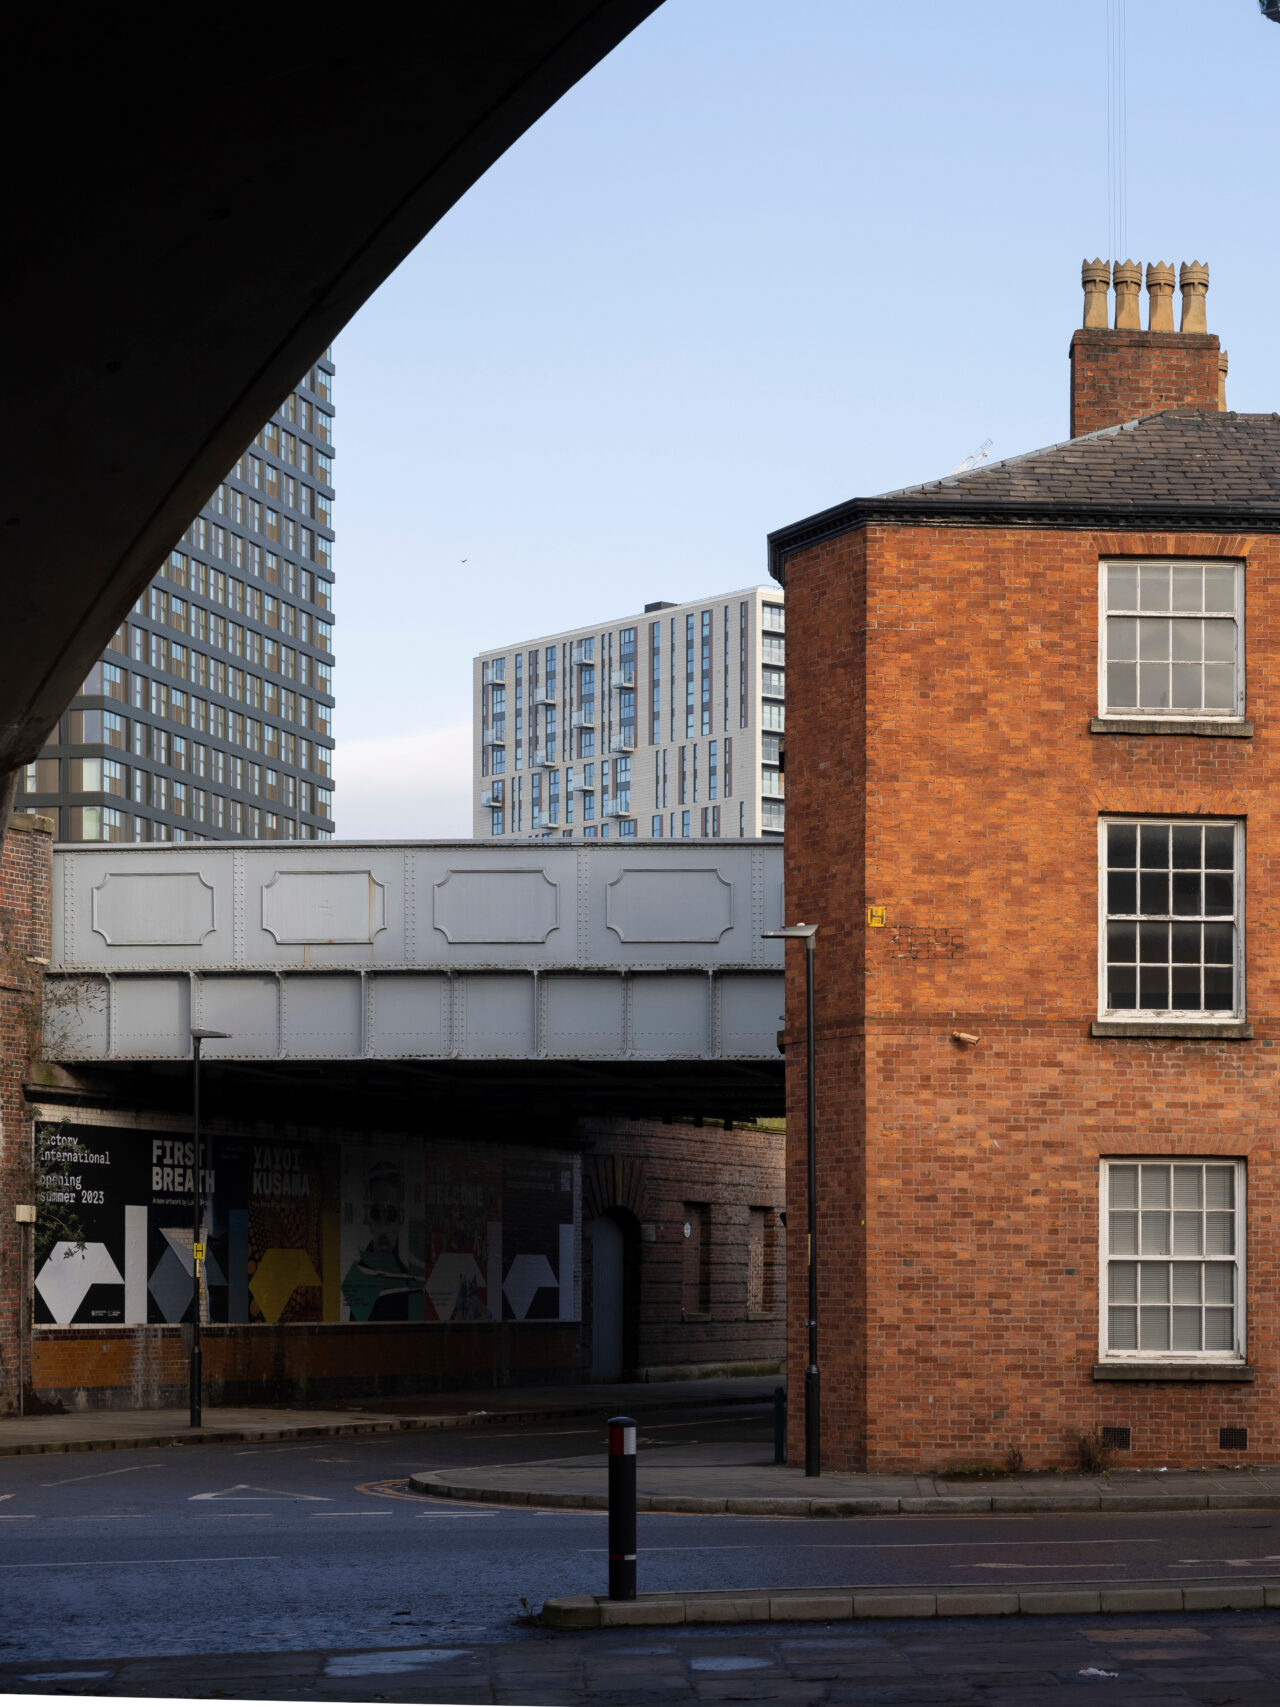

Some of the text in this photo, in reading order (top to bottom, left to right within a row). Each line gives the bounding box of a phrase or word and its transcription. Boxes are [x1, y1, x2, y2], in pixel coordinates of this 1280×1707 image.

[39, 1131, 79, 1147] fctory
[152, 1139, 206, 1166] FIRST
[252, 1144, 303, 1171] YAYOI
[152, 1166, 216, 1193] BREATH
[252, 1170, 311, 1197] KUSAMA
[40, 1190, 105, 1205] summer 2023
